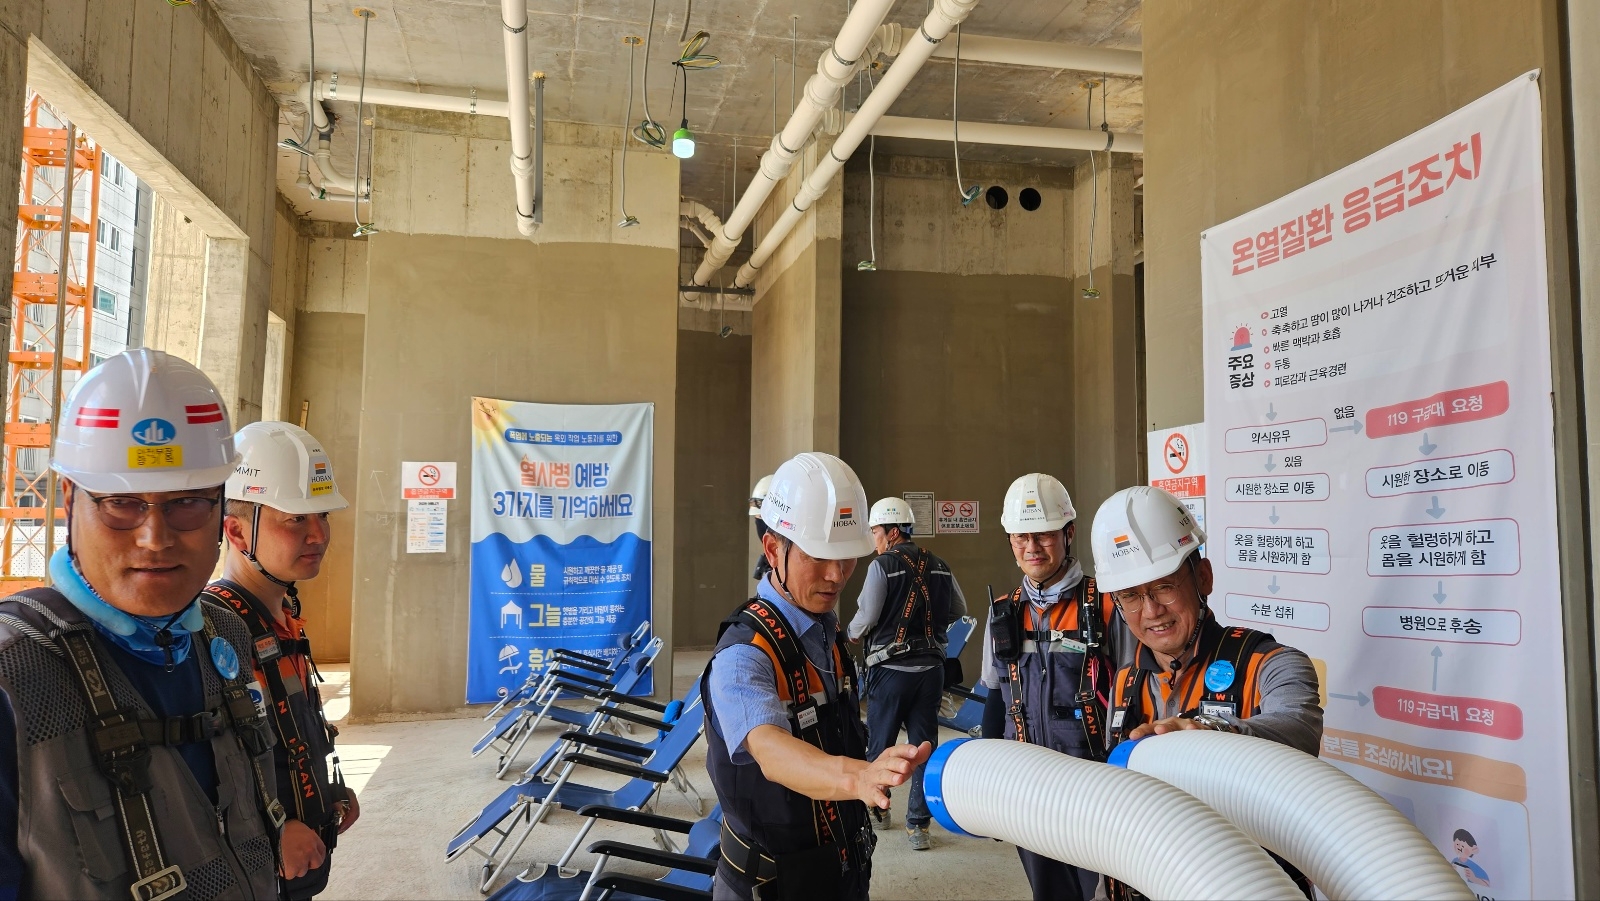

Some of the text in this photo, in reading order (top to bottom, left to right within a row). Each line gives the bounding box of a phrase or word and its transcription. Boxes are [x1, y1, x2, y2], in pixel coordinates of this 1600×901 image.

[1231, 132, 1481, 276] 온열질환 응급조치
[1270, 305, 1288, 320] 고열
[1271, 318, 1309, 336] 축축하고
[1310, 311, 1330, 328] 땀이
[1331, 304, 1351, 321] 많이
[1353, 295, 1384, 315] 나거나
[1386, 280, 1432, 305] 건조하고
[1272, 326, 1342, 353] 빠른 맥박과 호흡
[1228, 353, 1255, 371] 주요
[1274, 357, 1291, 371] 두통
[1229, 373, 1255, 390] 증상
[1274, 362, 1348, 388] 피로감과 근육경련
[1333, 405, 1356, 420] 없음
[1386, 394, 1484, 428] 119 구급대 요청
[568, 433, 580, 443] 작업
[606, 433, 618, 443] 위한
[1251, 430, 1291, 445] 의식유무
[1284, 455, 1303, 469] 있음
[311, 474, 332, 483] HOBAN
[520, 460, 610, 488] 열사병 예방
[1382, 460, 1490, 488] 시원한 장소로 이동
[1235, 480, 1316, 496] 시원한 장소로 이동
[493, 490, 634, 519] 3가지를 기억하세요
[833, 519, 857, 528] HOBAN
[1234, 533, 1315, 550] 옷을 헐렁하게 하고
[1380, 529, 1495, 550] 옷을 헐렁하게 하고
[1111, 544, 1140, 559] HOBAN
[1238, 549, 1312, 566] 몸을 시원하게 함
[1381, 549, 1487, 568] 몸을 시원하게 함
[529, 564, 547, 588] 물
[620, 573, 632, 582] 조치
[904, 591, 916, 618] HOBAN
[1250, 603, 1295, 620] 수분 섭취
[528, 603, 561, 627] 그늘
[747, 603, 787, 640] OBAN
[1400, 614, 1483, 635] 병원으로 후송
[1397, 698, 1495, 726] 119 구급대 요청
[1364, 742, 1454, 781] 조심하세요!
